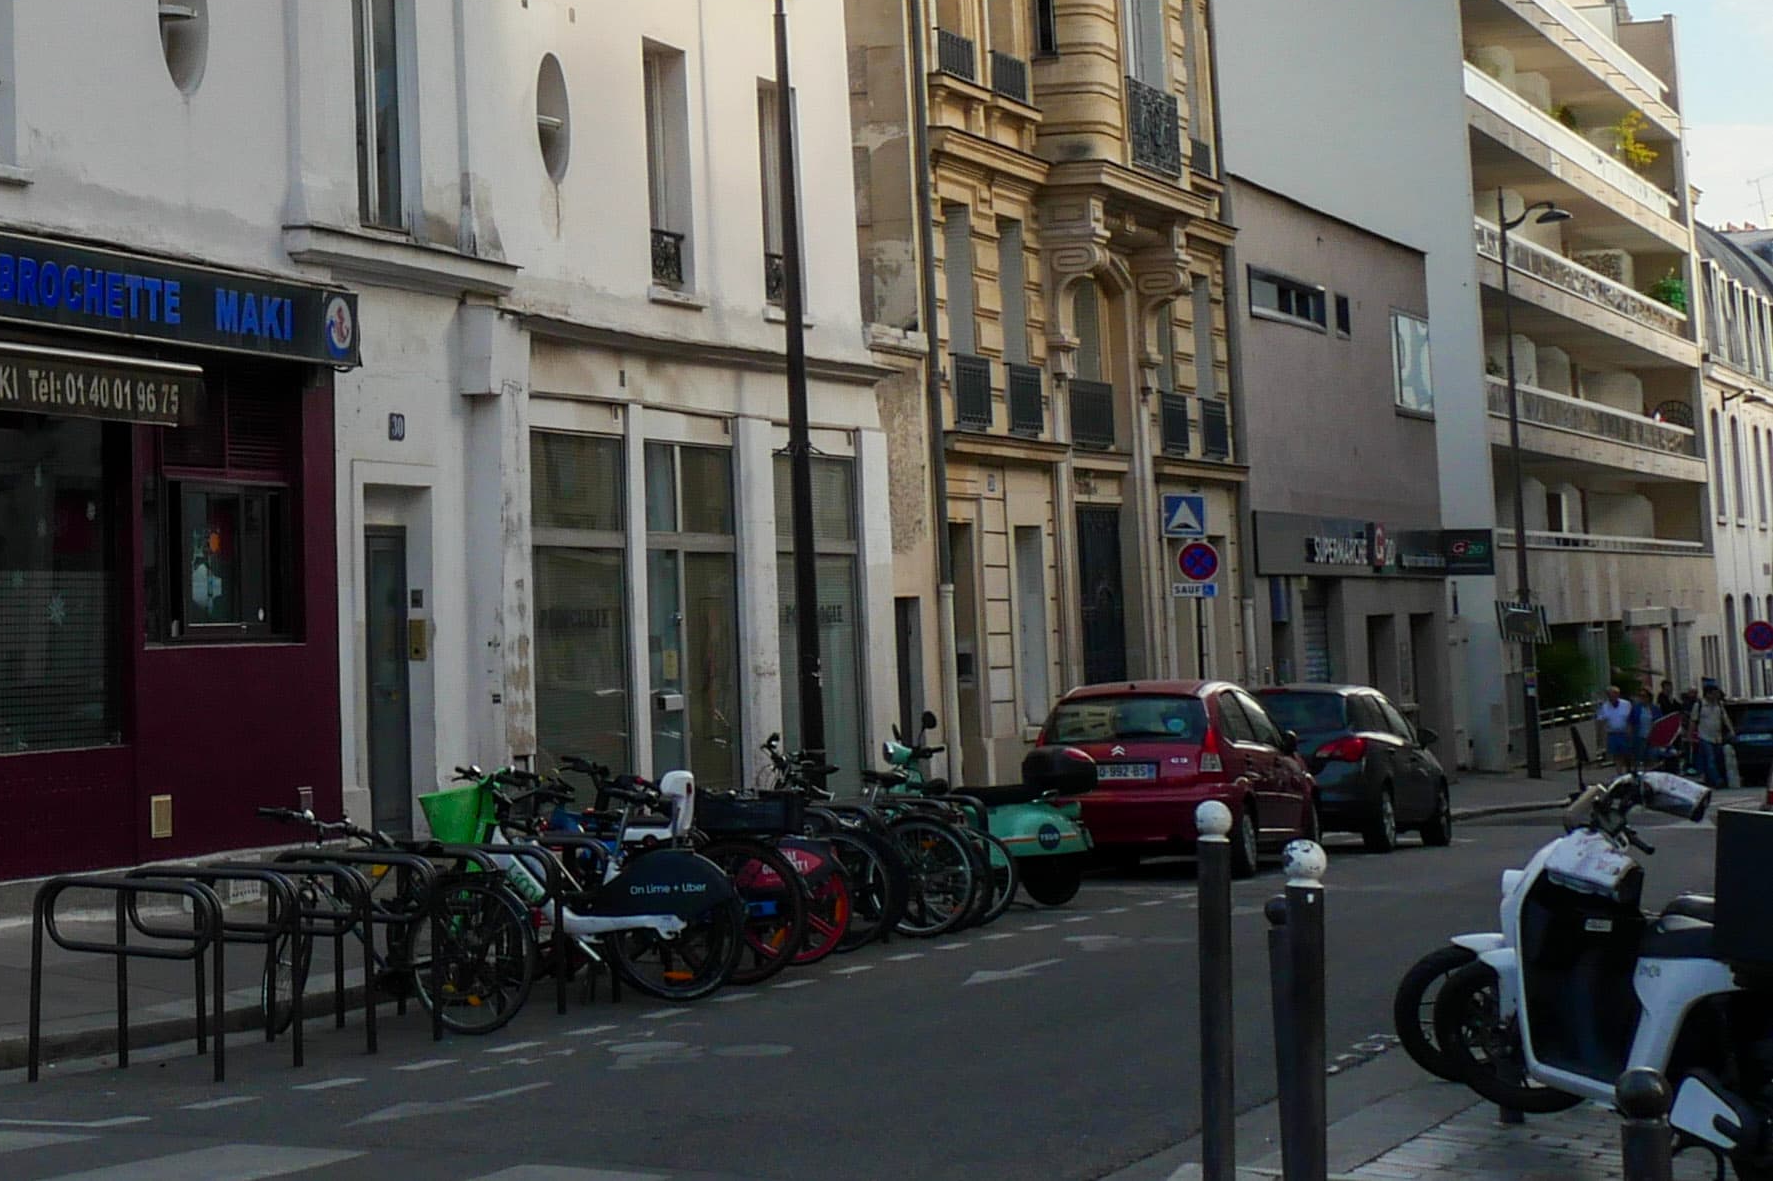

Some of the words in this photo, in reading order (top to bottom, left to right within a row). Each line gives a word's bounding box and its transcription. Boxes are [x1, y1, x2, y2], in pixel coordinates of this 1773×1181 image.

[215, 288, 293, 341] MAKI
[28, 369, 61, 404] Tél:
[65, 374, 85, 406] 01
[88, 376, 110, 408] 40
[113, 379, 131, 410] 01
[137, 381, 157, 413] 96
[162, 384, 179, 415] 75
[391, 415, 404, 437] 30
[1174, 585, 1201, 595] SAUF
[630, 885, 644, 895] On
[646, 883, 671, 894] Lime
[682, 882, 707, 893] Uber
